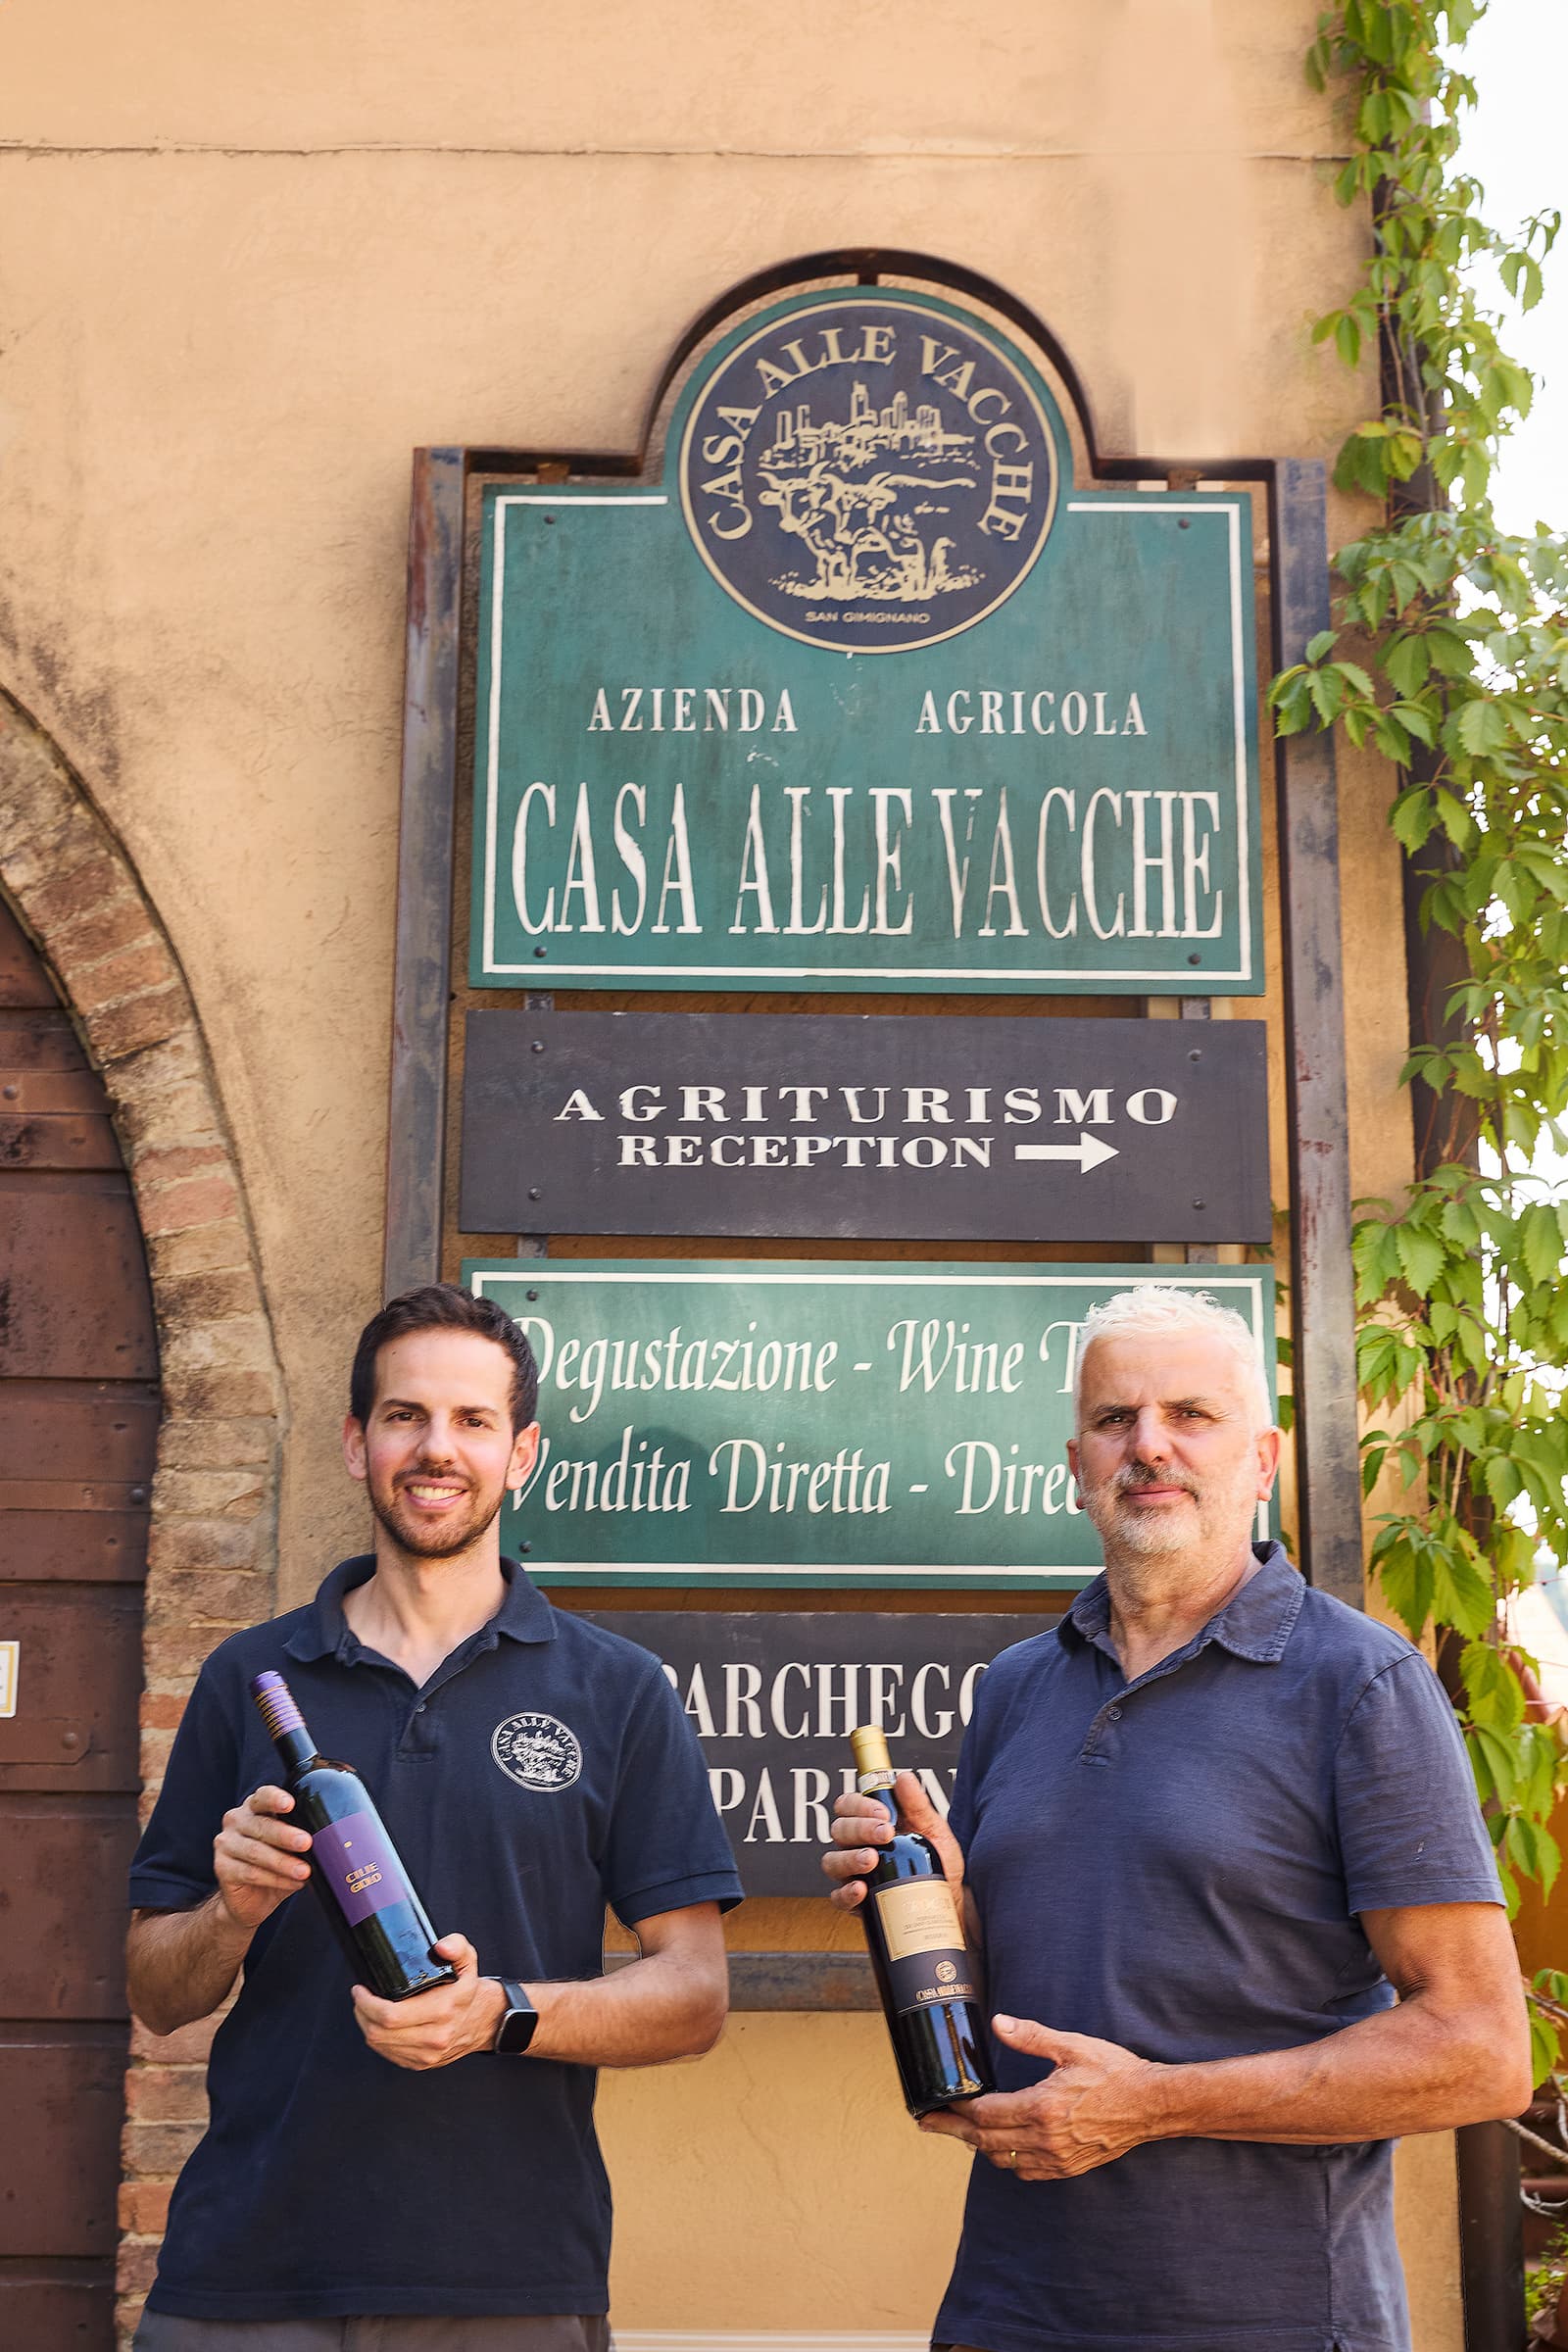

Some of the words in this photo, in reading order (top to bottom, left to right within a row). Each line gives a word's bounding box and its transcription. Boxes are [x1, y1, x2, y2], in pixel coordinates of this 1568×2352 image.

[701, 404, 762, 540] CASA
[756, 325, 897, 400] ALLE
[919, 335, 1034, 542] VACCHE
[805, 611, 839, 622] SAN
[842, 611, 931, 624] GIMIGNANO
[587, 688, 799, 733] AZIENDA
[915, 689, 1148, 736] AGRICOLA
[512, 782, 703, 935] CASA
[728, 783, 913, 935] ALLE
[931, 786, 1222, 939] VACCHE
[554, 1085, 1178, 1125] AGRITURISMO
[616, 1135, 996, 1169] RECEPTION
[886, 1318, 1025, 1394] Wine
[513, 1425, 693, 1512] Vendita
[709, 1439, 893, 1514] Diretta
